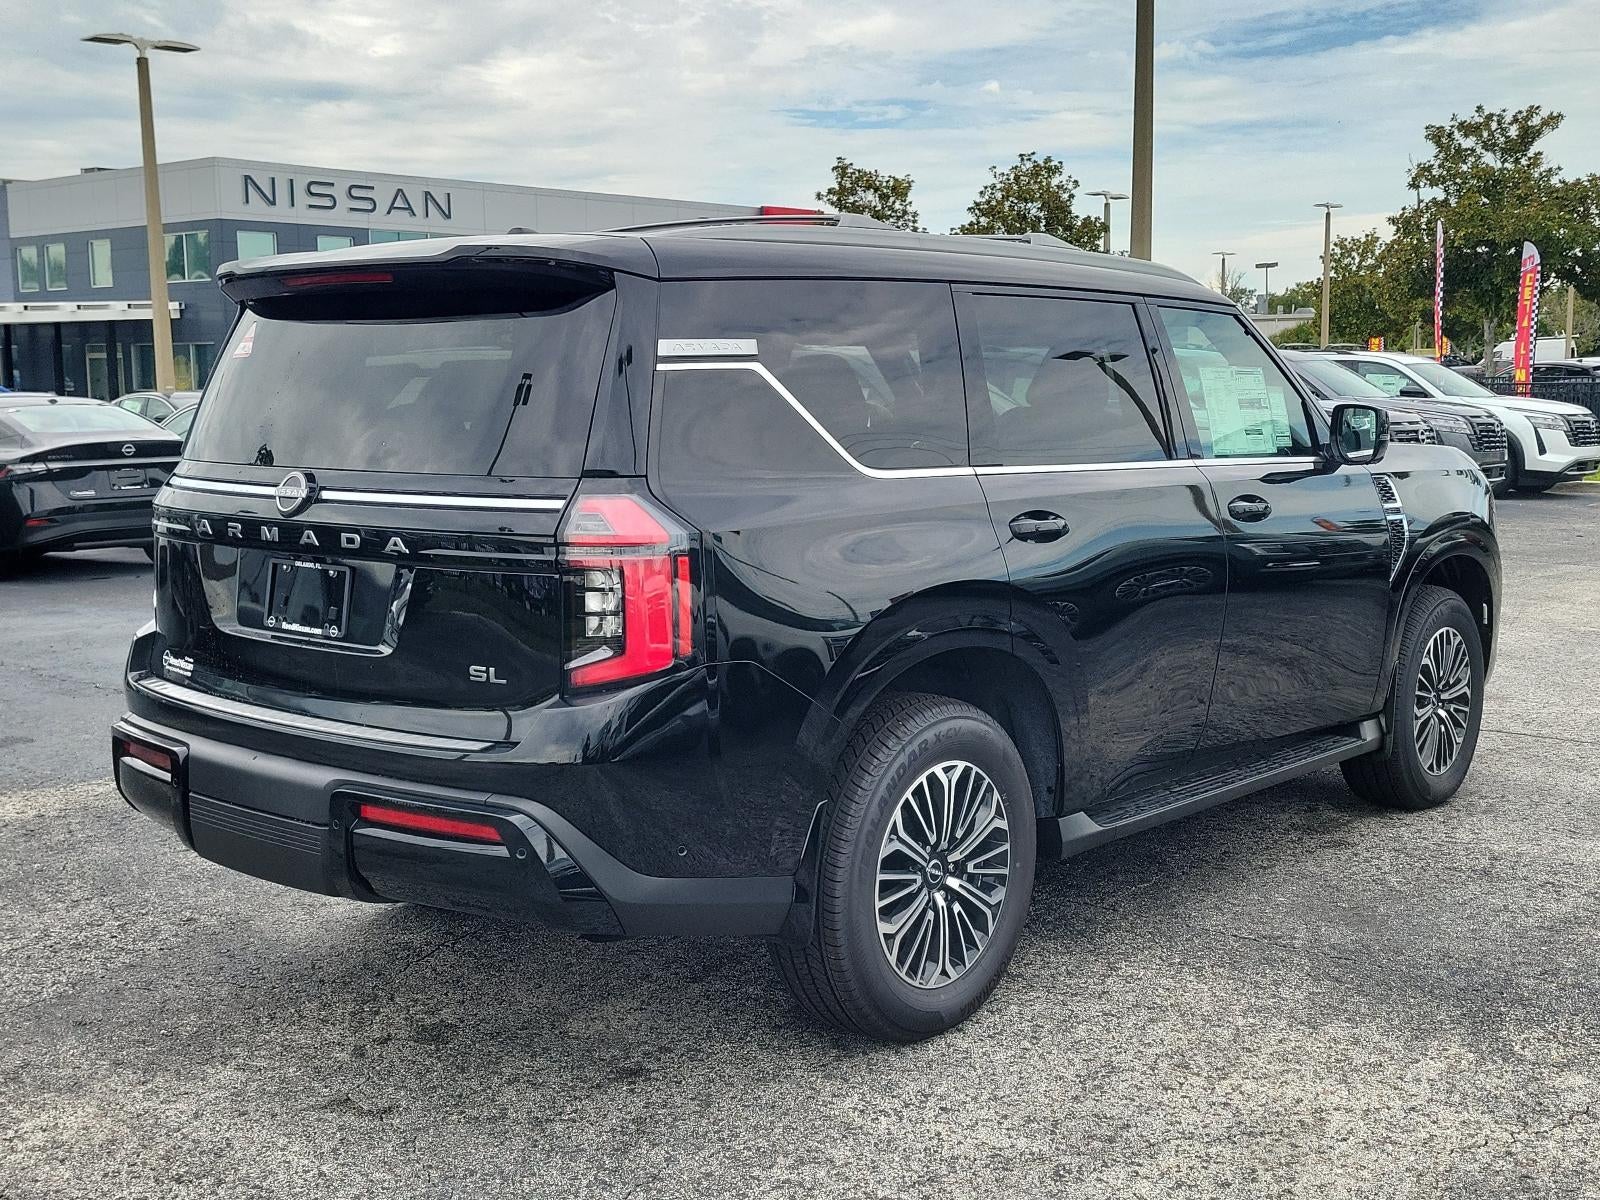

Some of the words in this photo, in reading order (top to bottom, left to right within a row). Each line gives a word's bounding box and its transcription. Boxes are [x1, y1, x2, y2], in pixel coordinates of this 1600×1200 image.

[242, 174, 452, 220] NISSAN
[672, 343, 743, 352] ARMADA
[275, 487, 308, 497] NISSAN
[198, 519, 409, 554] ARMADA
[469, 665, 507, 684] SL
